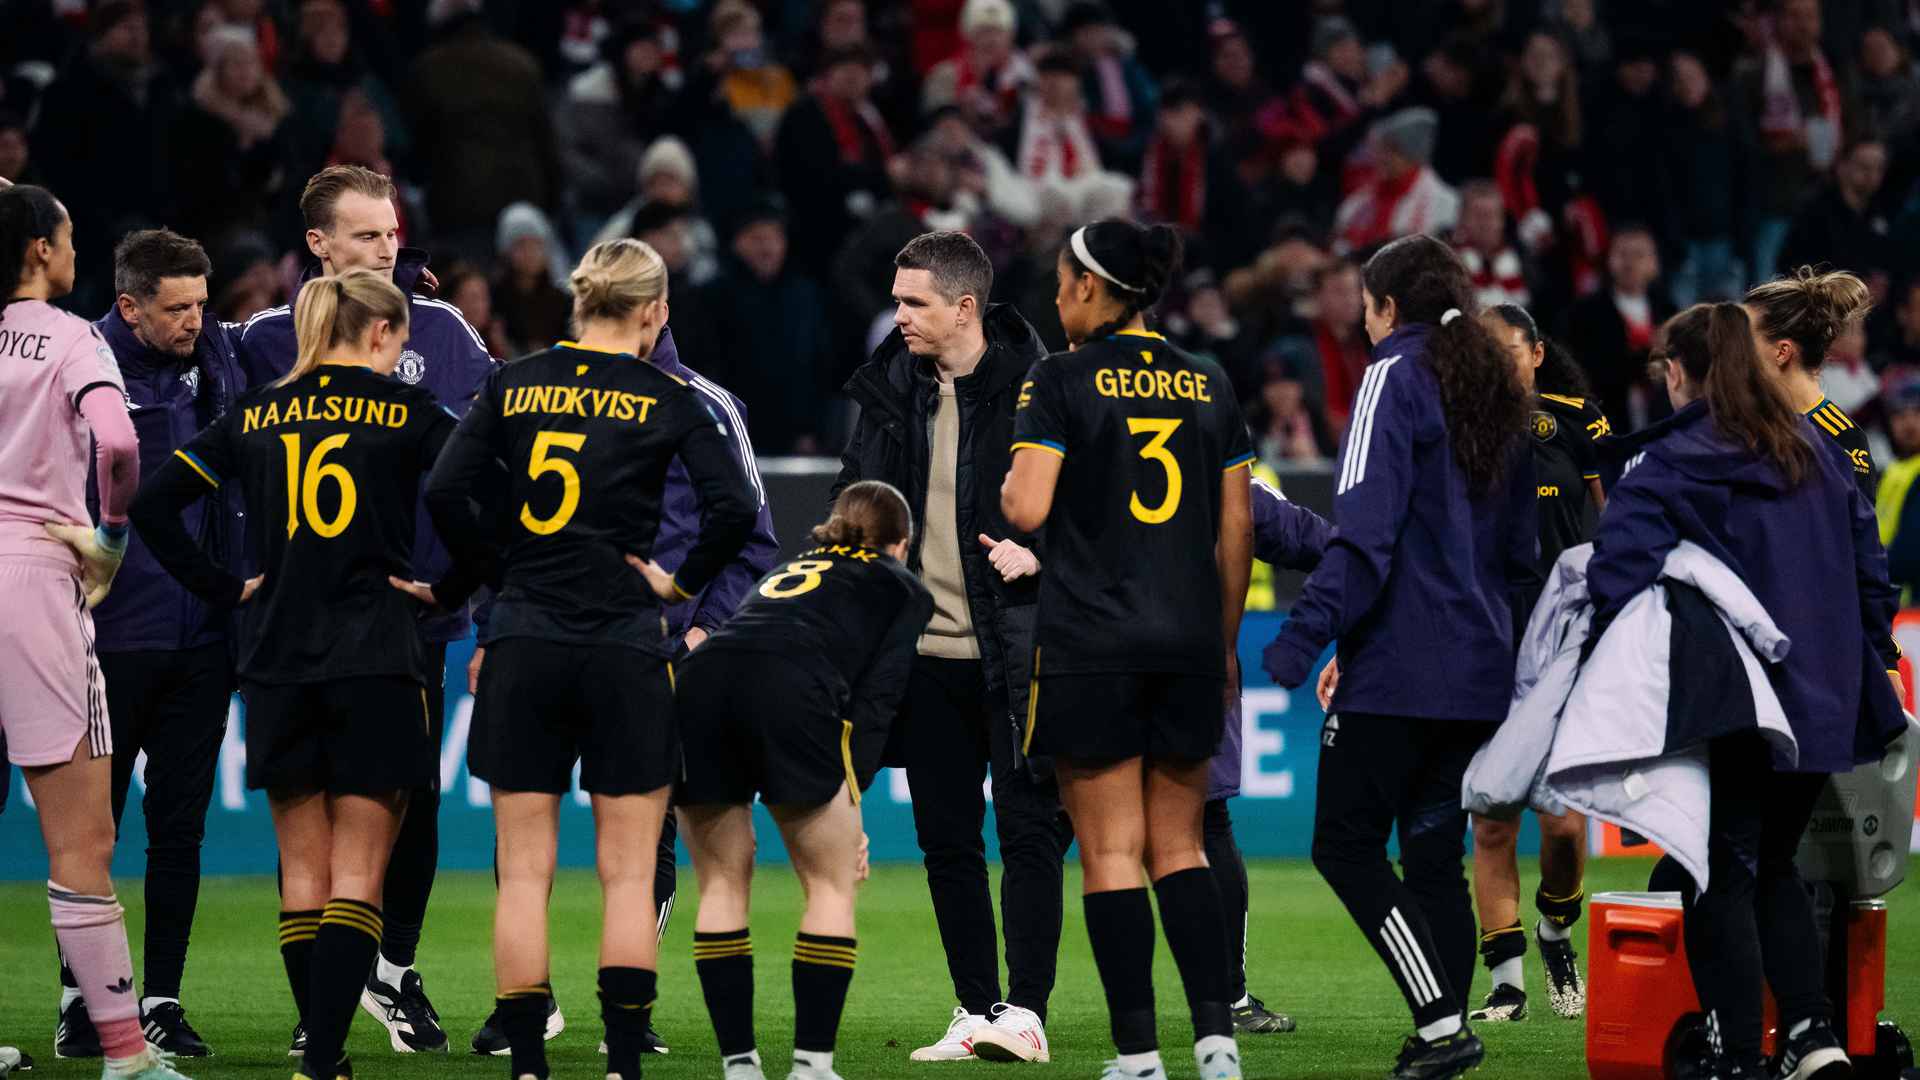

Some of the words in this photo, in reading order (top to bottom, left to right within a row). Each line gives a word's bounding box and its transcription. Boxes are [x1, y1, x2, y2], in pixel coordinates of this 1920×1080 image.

[503, 385, 657, 424] LUNDKVIST
[1095, 368, 1211, 402] GEORGE
[242, 395, 409, 434] NAALSUND
[279, 433, 357, 541] 16
[519, 431, 587, 535] 5
[1126, 417, 1183, 524] 3
[759, 560, 833, 599] 8
